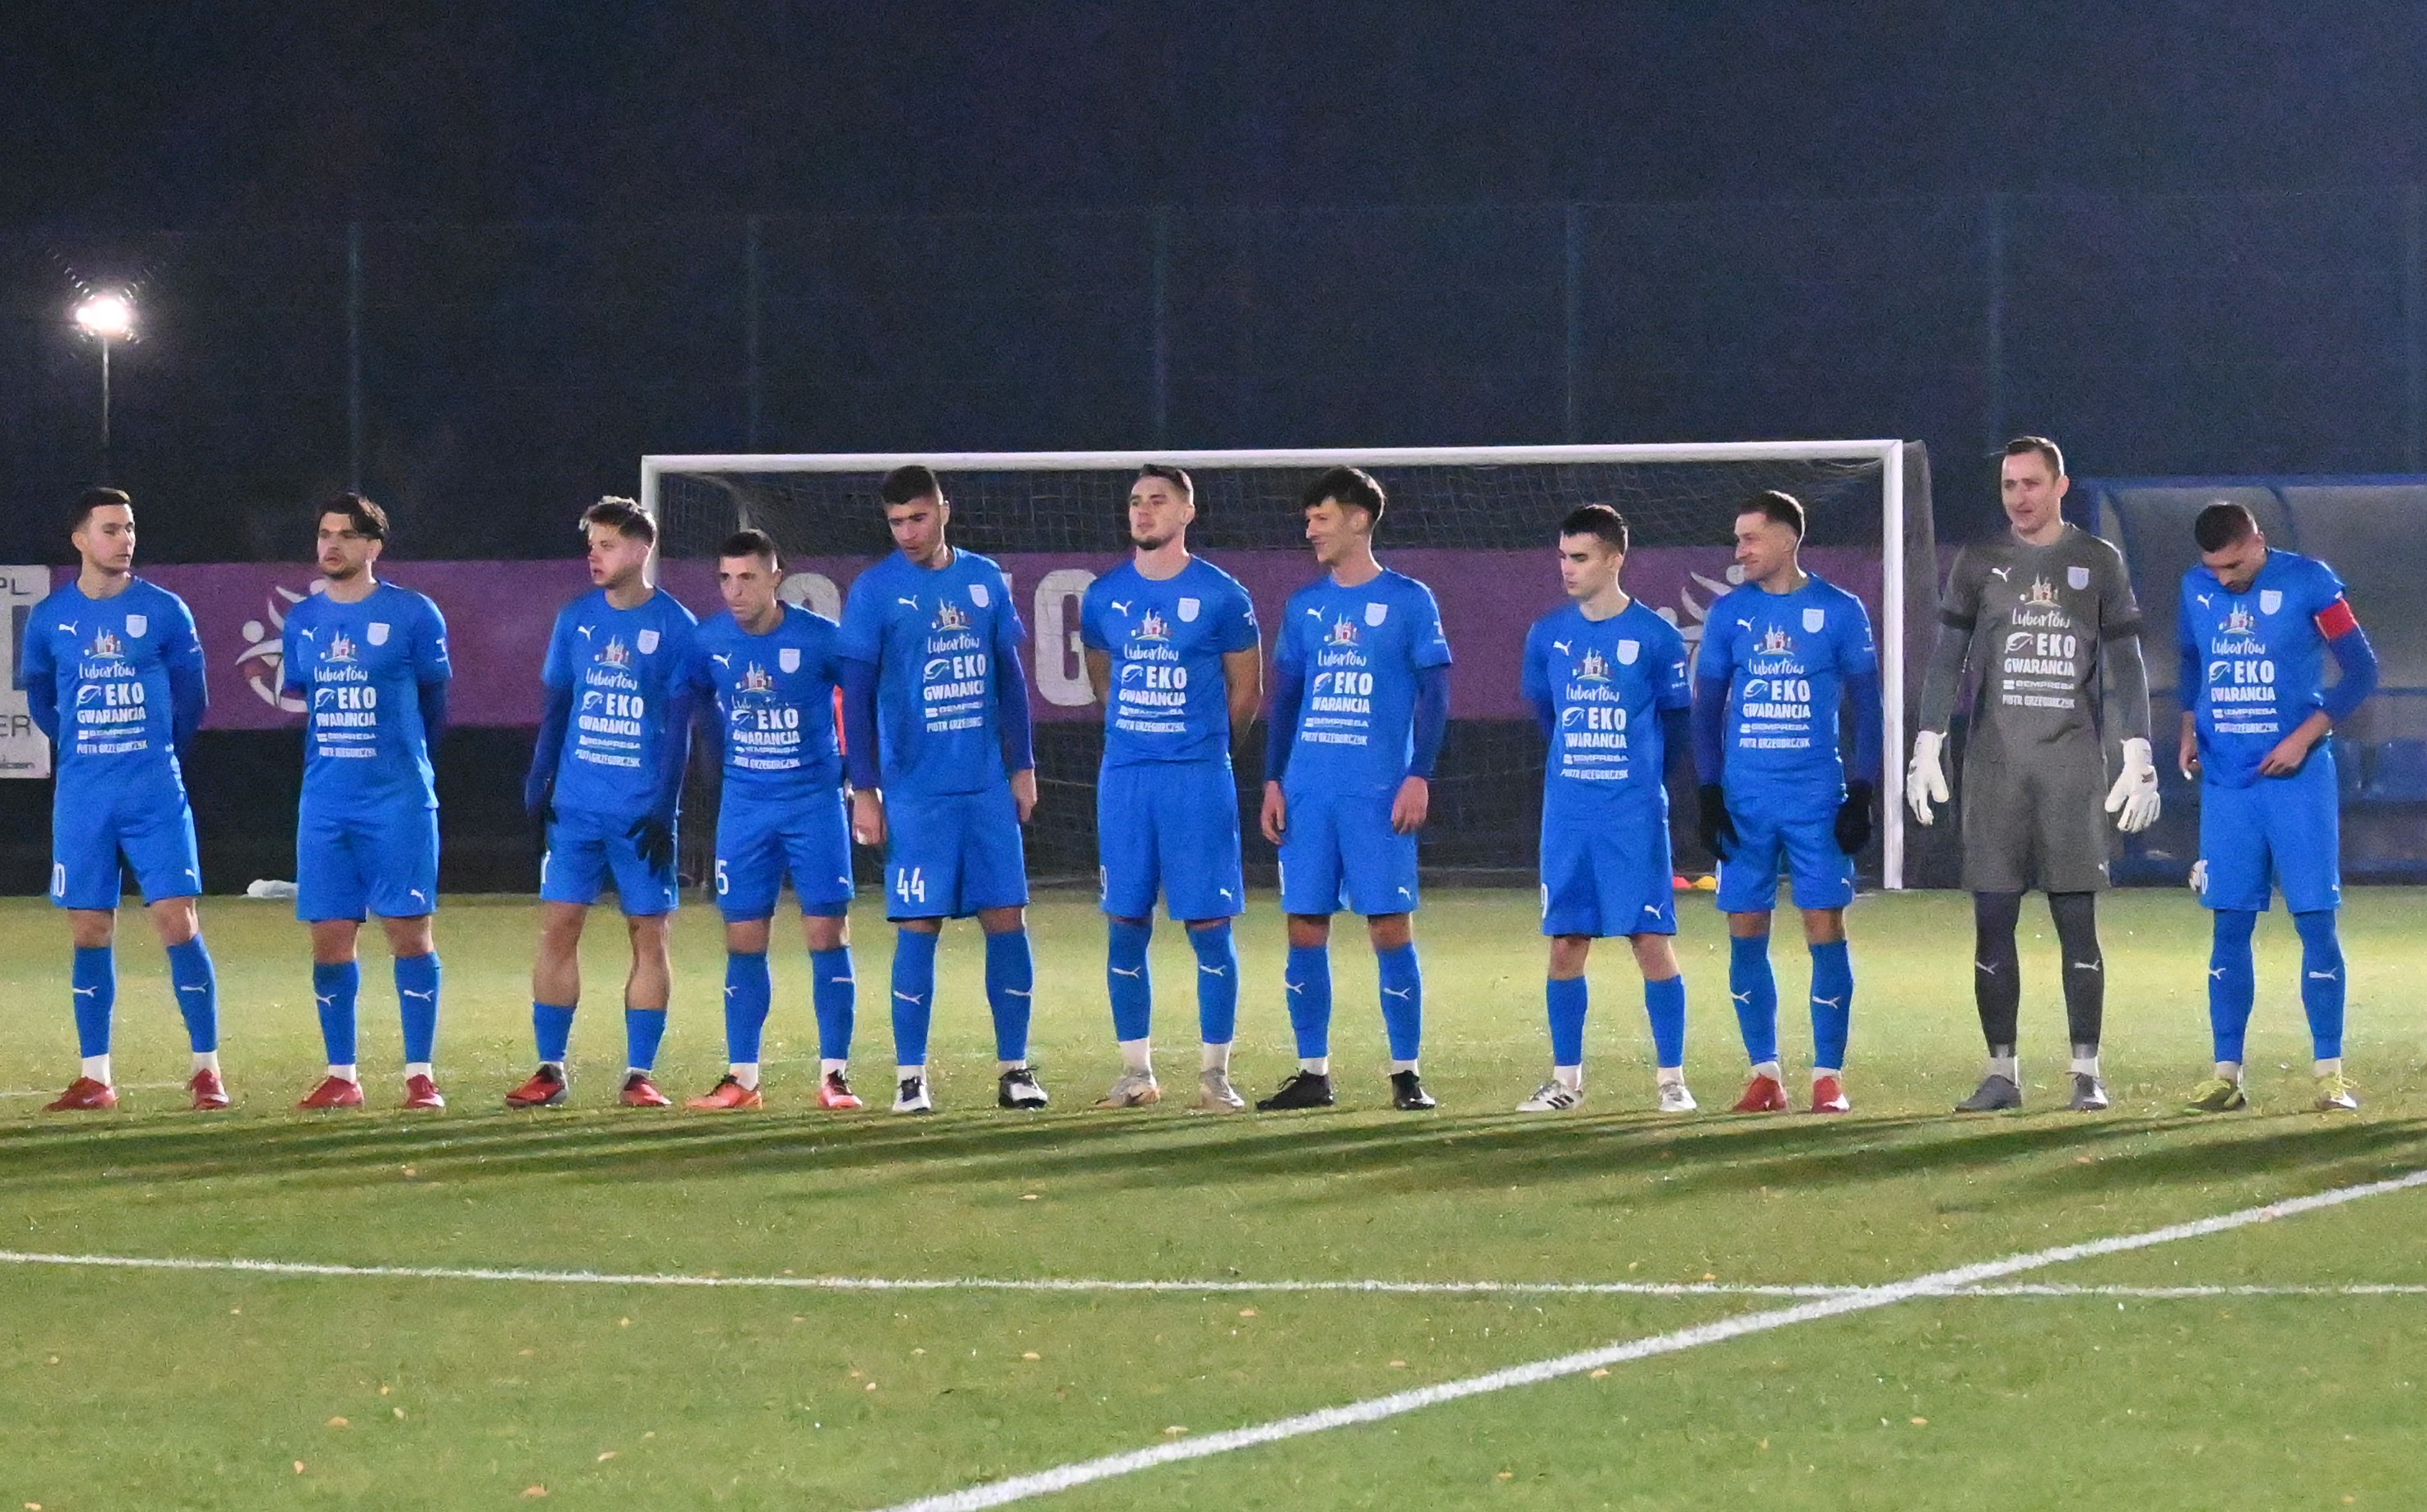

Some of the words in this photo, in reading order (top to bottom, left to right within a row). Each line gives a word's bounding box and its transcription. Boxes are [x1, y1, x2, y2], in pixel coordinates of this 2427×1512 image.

[2012, 608, 2070, 628] Lubartów
[927, 633, 979, 655] Lubartów
[1123, 643, 1179, 662] Lubartów
[2037, 632, 2077, 659] EKO
[2212, 637, 2267, 655] Lubartów
[79, 661, 136, 679] Lubartów
[314, 665, 368, 682] Lubartów
[952, 654, 987, 679] EKO
[1146, 666, 1187, 689] EKO
[1749, 657, 1804, 675] Lubartów
[2004, 657, 2075, 677] GWARANCJA
[2234, 659, 2276, 684] EKO
[586, 668, 637, 691] Lubartów
[1334, 672, 1374, 695] EKO
[1772, 679, 1811, 702] EKO
[106, 682, 144, 706] EKO
[337, 686, 376, 709] EKO
[1118, 688, 1186, 706] GWARANCJA
[1566, 683, 1620, 702] Lubartów
[77, 706, 146, 724] GWARANCJA
[606, 694, 644, 719] EKO
[757, 708, 799, 730] EKO
[1587, 707, 1628, 731] EKO
[715, 858, 728, 895] 5
[897, 867, 925, 902] 44
